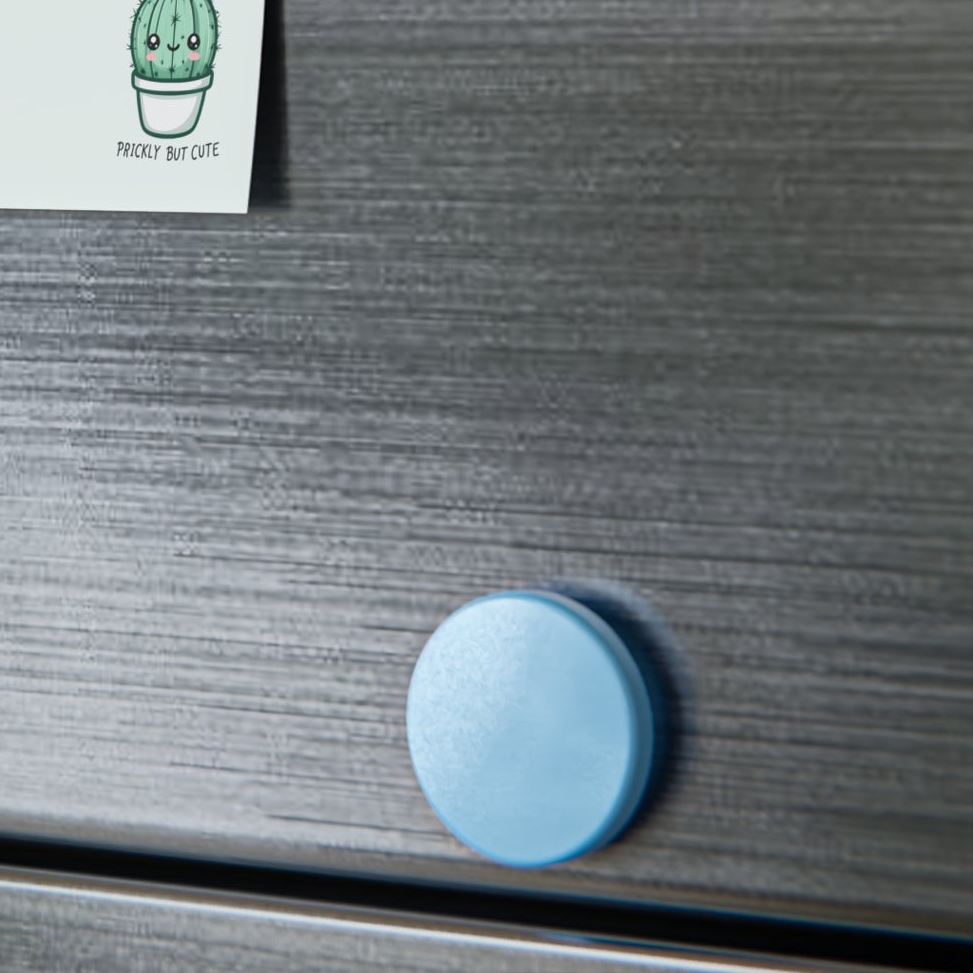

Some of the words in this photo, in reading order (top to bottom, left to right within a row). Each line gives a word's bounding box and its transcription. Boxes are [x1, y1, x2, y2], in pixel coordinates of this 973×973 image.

[117, 141, 161, 160] PRICKLY
[165, 145, 188, 161] BUT
[191, 142, 220, 160] CUTE
